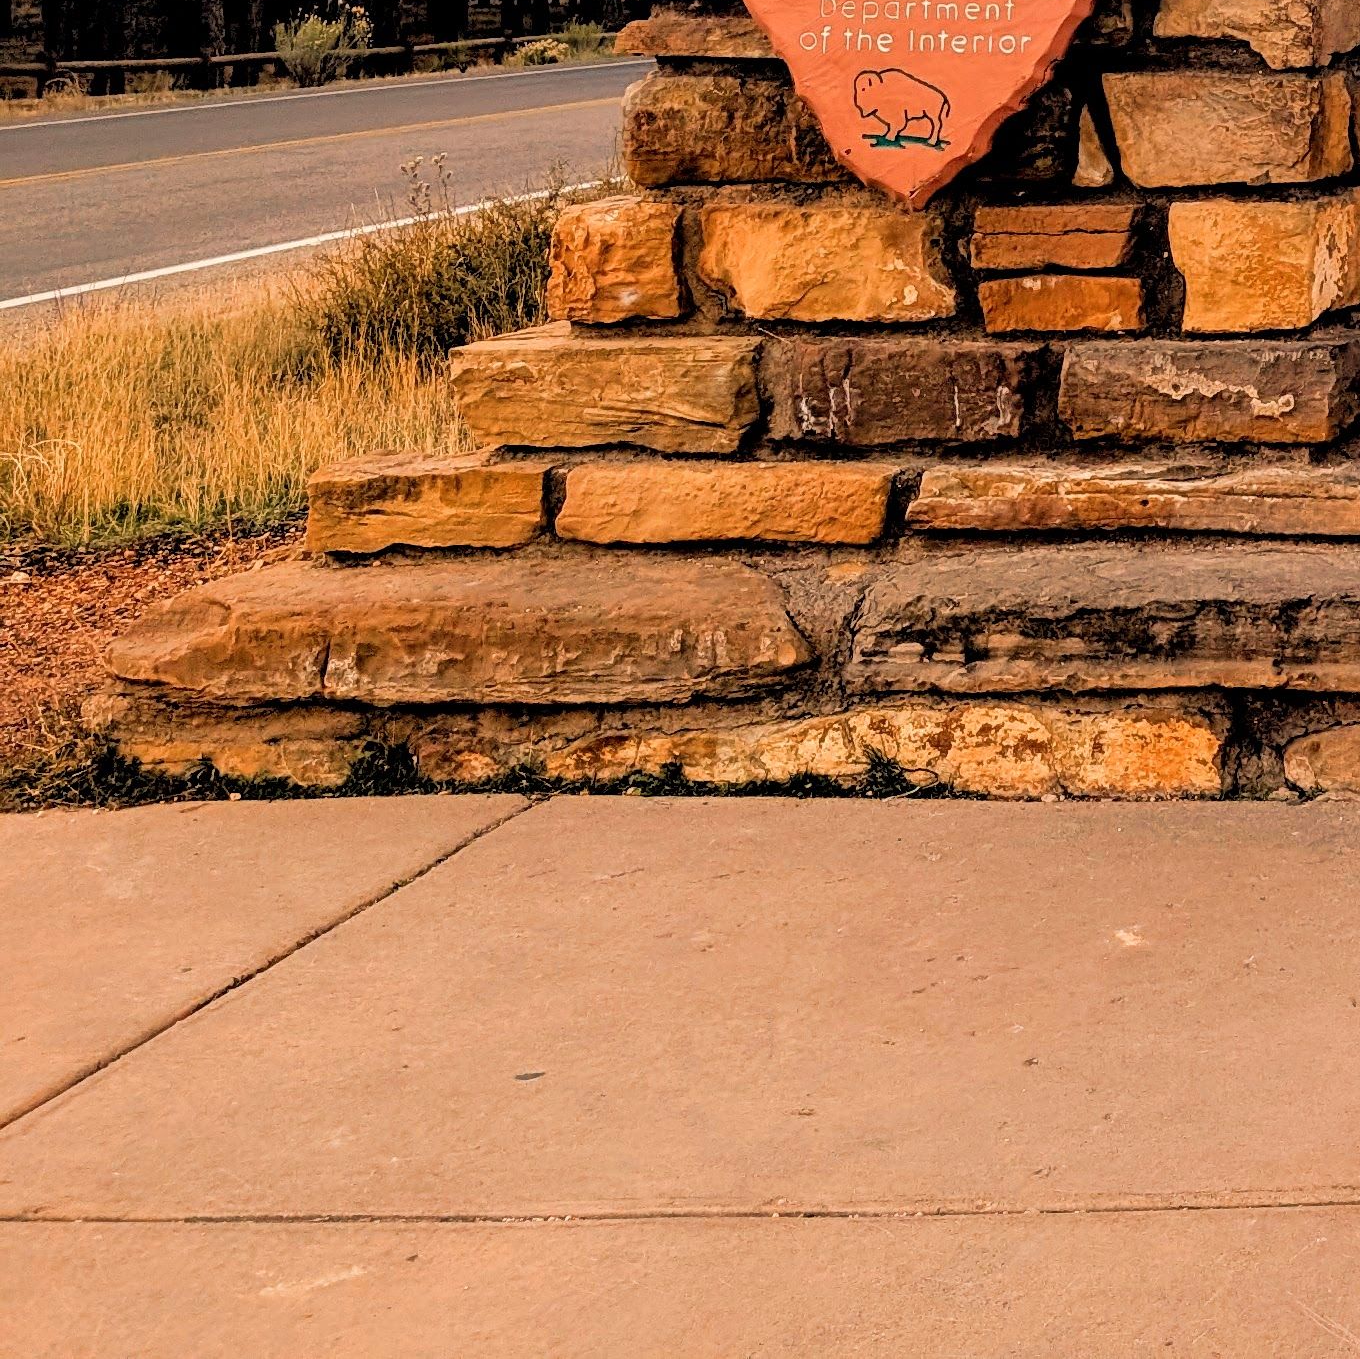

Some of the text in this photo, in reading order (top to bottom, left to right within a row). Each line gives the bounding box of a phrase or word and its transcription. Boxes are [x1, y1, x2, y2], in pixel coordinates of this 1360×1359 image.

[800, 25, 1032, 54] of the Interior
